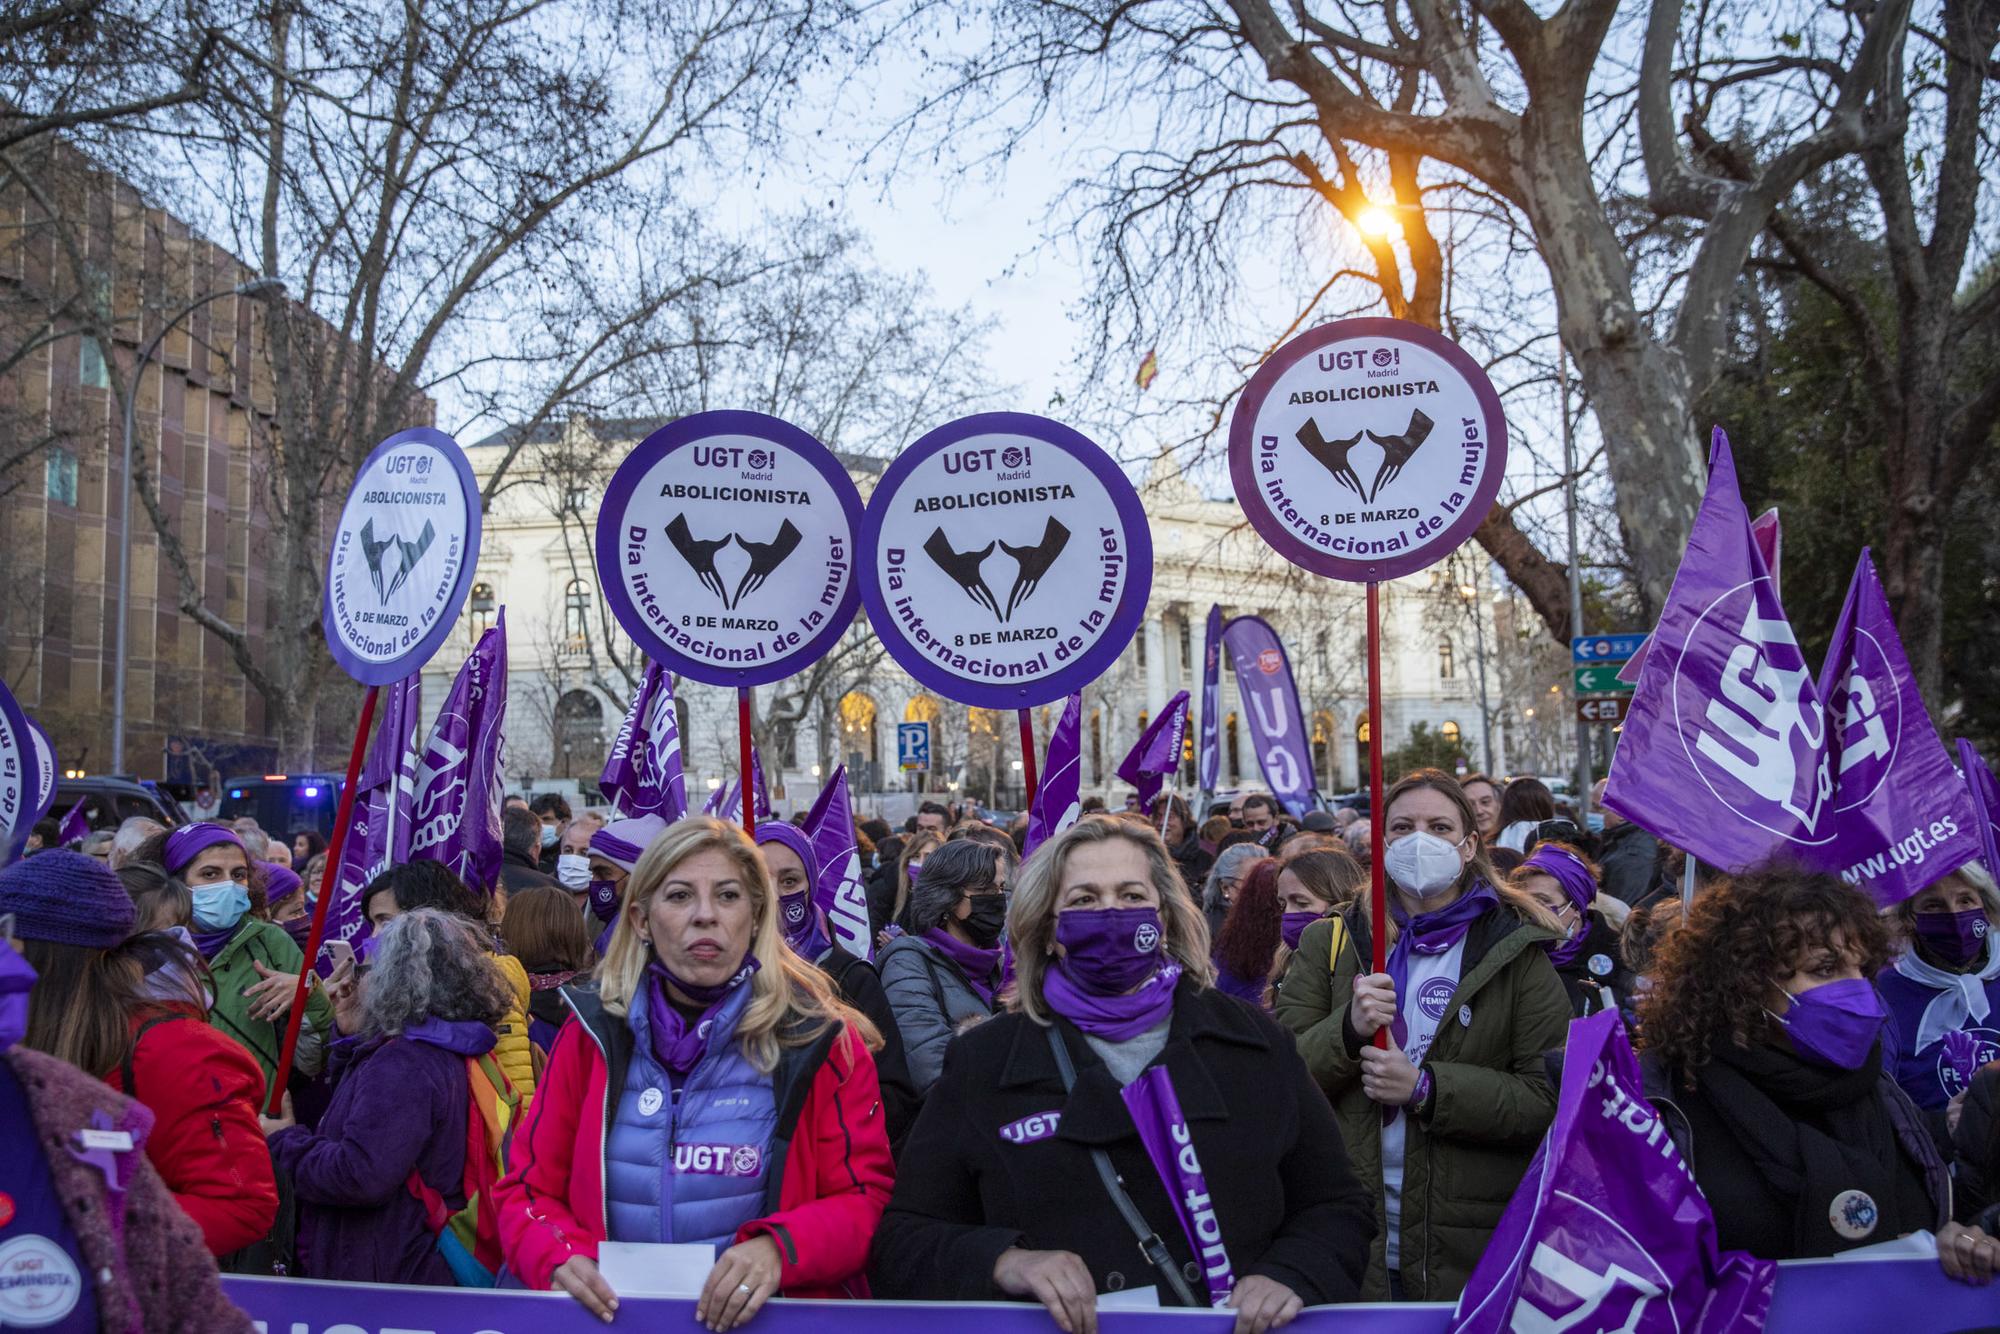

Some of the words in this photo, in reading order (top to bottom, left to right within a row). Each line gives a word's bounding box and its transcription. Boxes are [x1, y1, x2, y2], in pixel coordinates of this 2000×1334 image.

[1318, 350, 1368, 373] UGT
[1367, 368, 1399, 378] Madrid
[1288, 380, 1440, 405] ABOLICIONISTA
[693, 446, 744, 468] UGT
[943, 449, 996, 475] UGT
[1260, 434, 1279, 474] Día
[1459, 417, 1485, 486] mujer
[386, 456, 416, 474] UGT
[741, 471, 773, 481] Madrid
[997, 470, 1031, 482] Madrid
[410, 477, 428, 485] Madrid
[363, 491, 446, 505] ABOLICIONISTA
[660, 484, 811, 505] ABOLICIONISTA
[913, 484, 1075, 513] ABOLICIONISTA
[1440, 491, 1466, 514] la
[1265, 478, 1410, 555] internacional
[1320, 514, 1330, 526] 8
[1335, 512, 1356, 525] DE
[1361, 507, 1420, 523] MARZO
[1415, 515, 1444, 540] de
[627, 525, 648, 566] Día
[820, 535, 848, 607] mujer
[886, 548, 906, 591] Día
[1098, 526, 1124, 603] mujer
[335, 573, 397, 656] internacional
[402, 626, 419, 648] de
[422, 606, 437, 627] la
[435, 533, 459, 601] mujer
[355, 611, 361, 622] 8
[362, 612, 374, 624] DE
[376, 613, 408, 626] MARZO
[631, 573, 766, 662] internacional
[682, 615, 691, 627] 8
[696, 616, 717, 628] DE
[722, 618, 779, 632] MARZO
[799, 609, 824, 632] la
[1079, 608, 1106, 634] la
[772, 630, 801, 654] de
[895, 596, 1049, 678] internacional
[954, 634, 965, 647] 8
[970, 632, 992, 646] DE
[997, 626, 1059, 644] MARZO
[1054, 635, 1084, 662] de
[902, 729, 926, 758] P
[4, 757, 16, 779] la
[1004, 1113, 1061, 1142] UGT
[675, 1146, 731, 1171] UGT
[0, 1273, 73, 1290] EMINISTA
